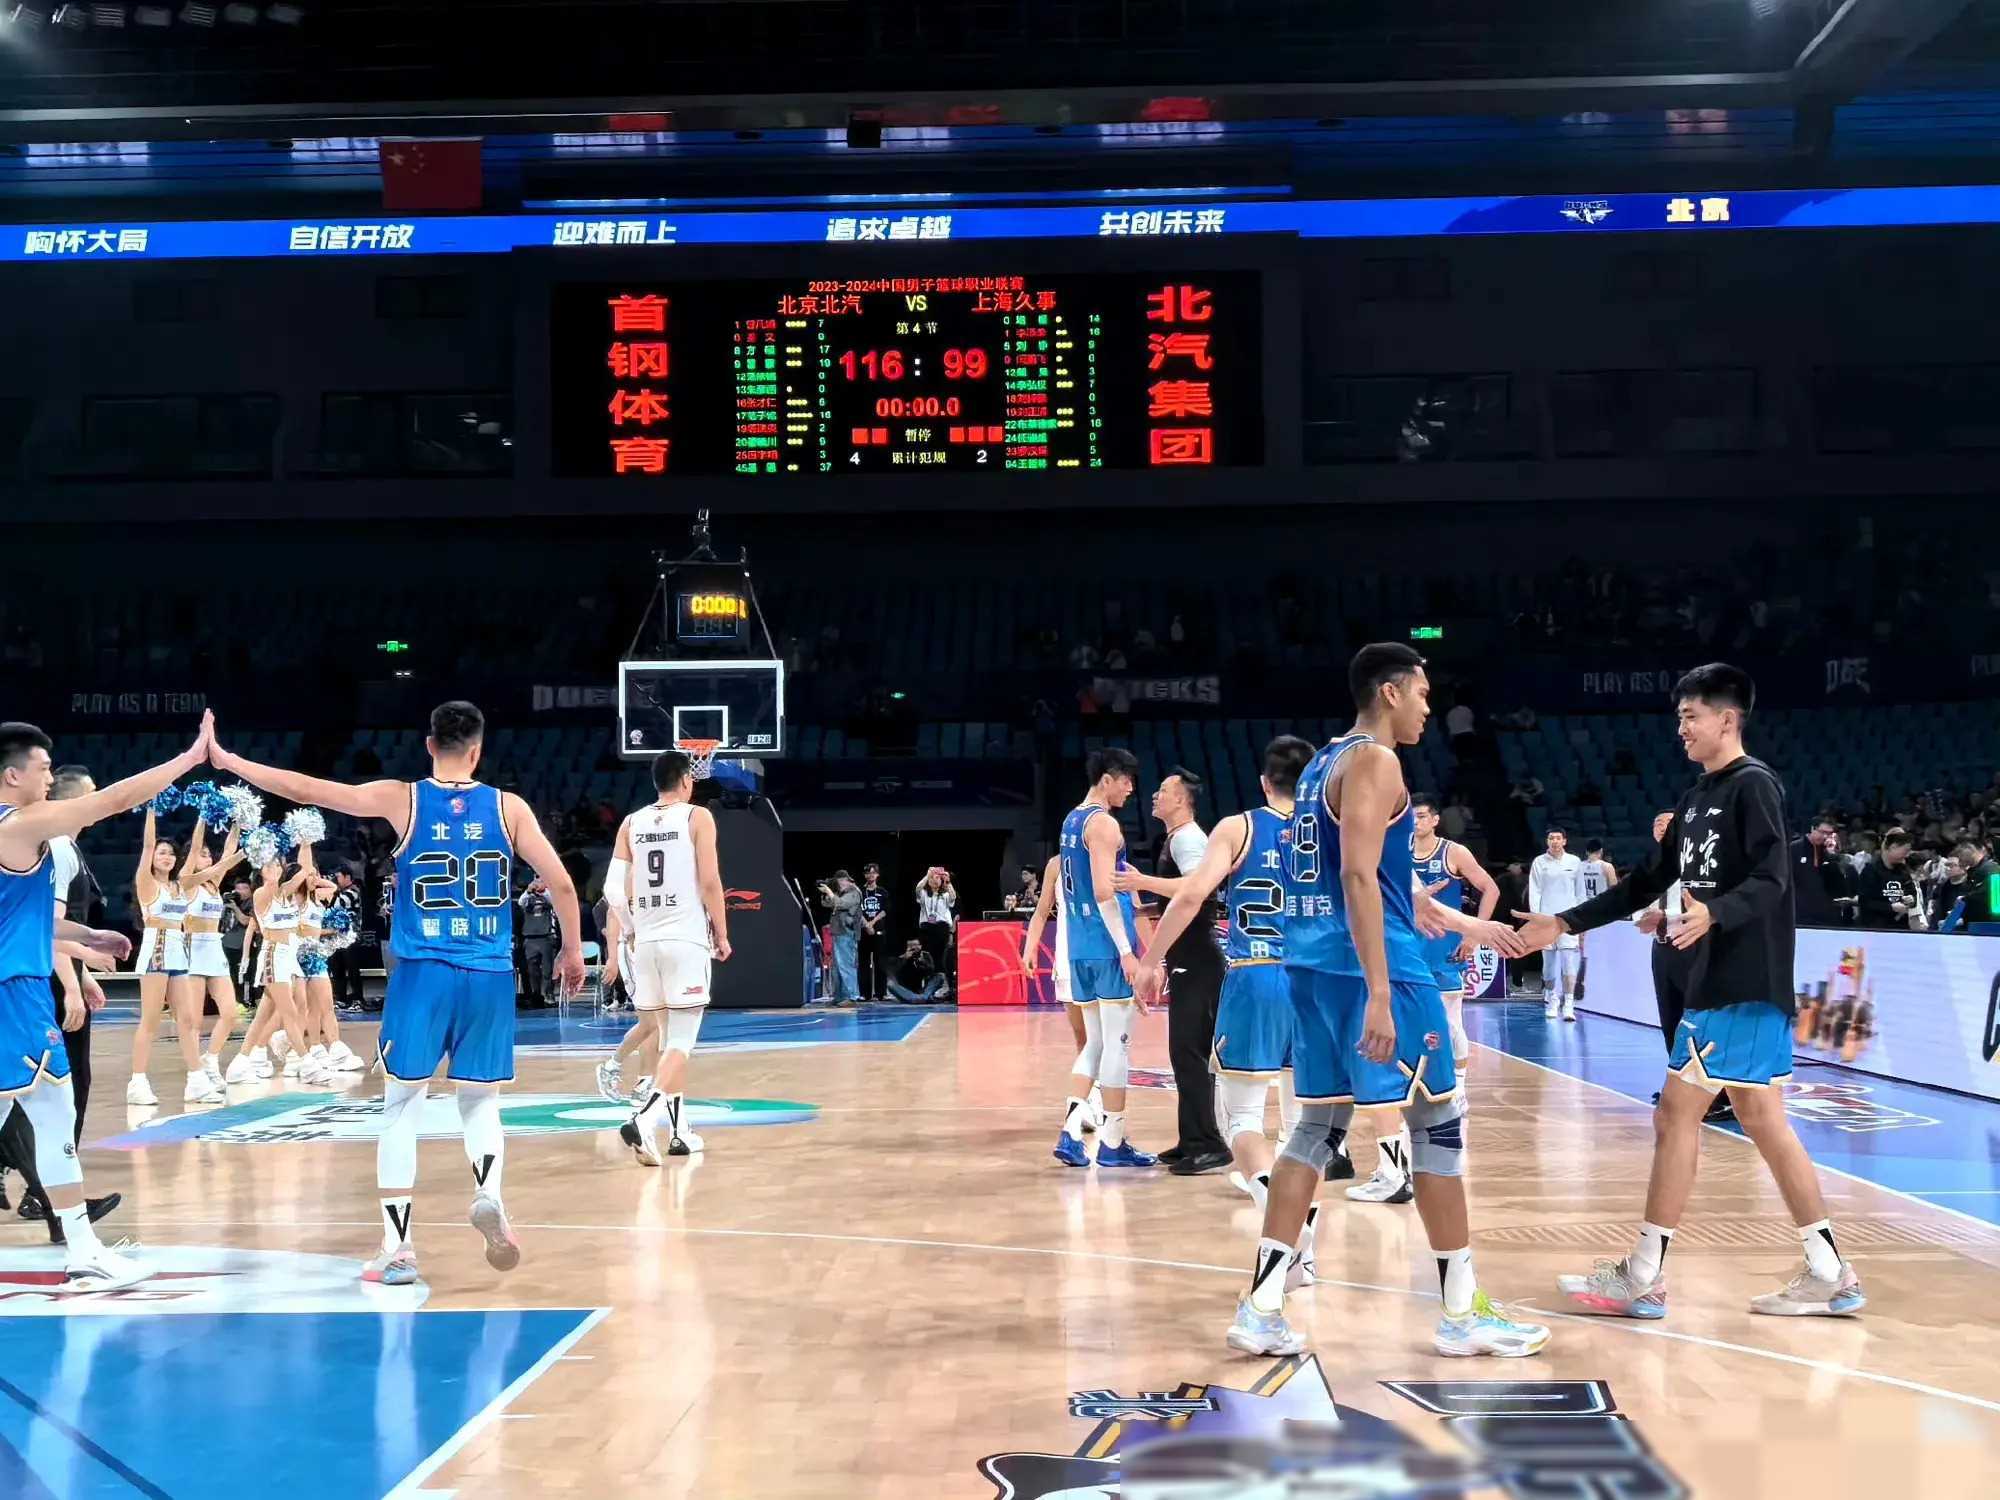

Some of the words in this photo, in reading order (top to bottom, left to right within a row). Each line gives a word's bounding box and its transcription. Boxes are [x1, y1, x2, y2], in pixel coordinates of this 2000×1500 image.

[1099, 209, 1225, 236] 共创未来
[1666, 197, 1730, 223] 北京
[289, 224, 415, 250] 自信开放
[552, 220, 677, 246] 迎难而上
[825, 215, 952, 241] 追求卓越
[24, 229, 149, 254] 胸怀大局
[777, 294, 863, 315] 北京北汽
[905, 296, 927, 312] VS
[970, 291, 1057, 312] 上海久事
[912, 322, 921, 334] 4
[839, 350, 904, 380] 116
[943, 348, 988, 379] 99
[1147, 285, 1213, 465] 北汽集团
[607, 294, 670, 473] 首钢体育
[876, 397, 960, 417] 00:00.0
[905, 428, 931, 442] 暂停
[849, 451, 861, 465] 4
[892, 451, 946, 464] 累计犯规
[976, 449, 988, 463] 2
[431, 822, 483, 840] 北汽
[409, 850, 510, 910] 20
[648, 849, 665, 888] 9
